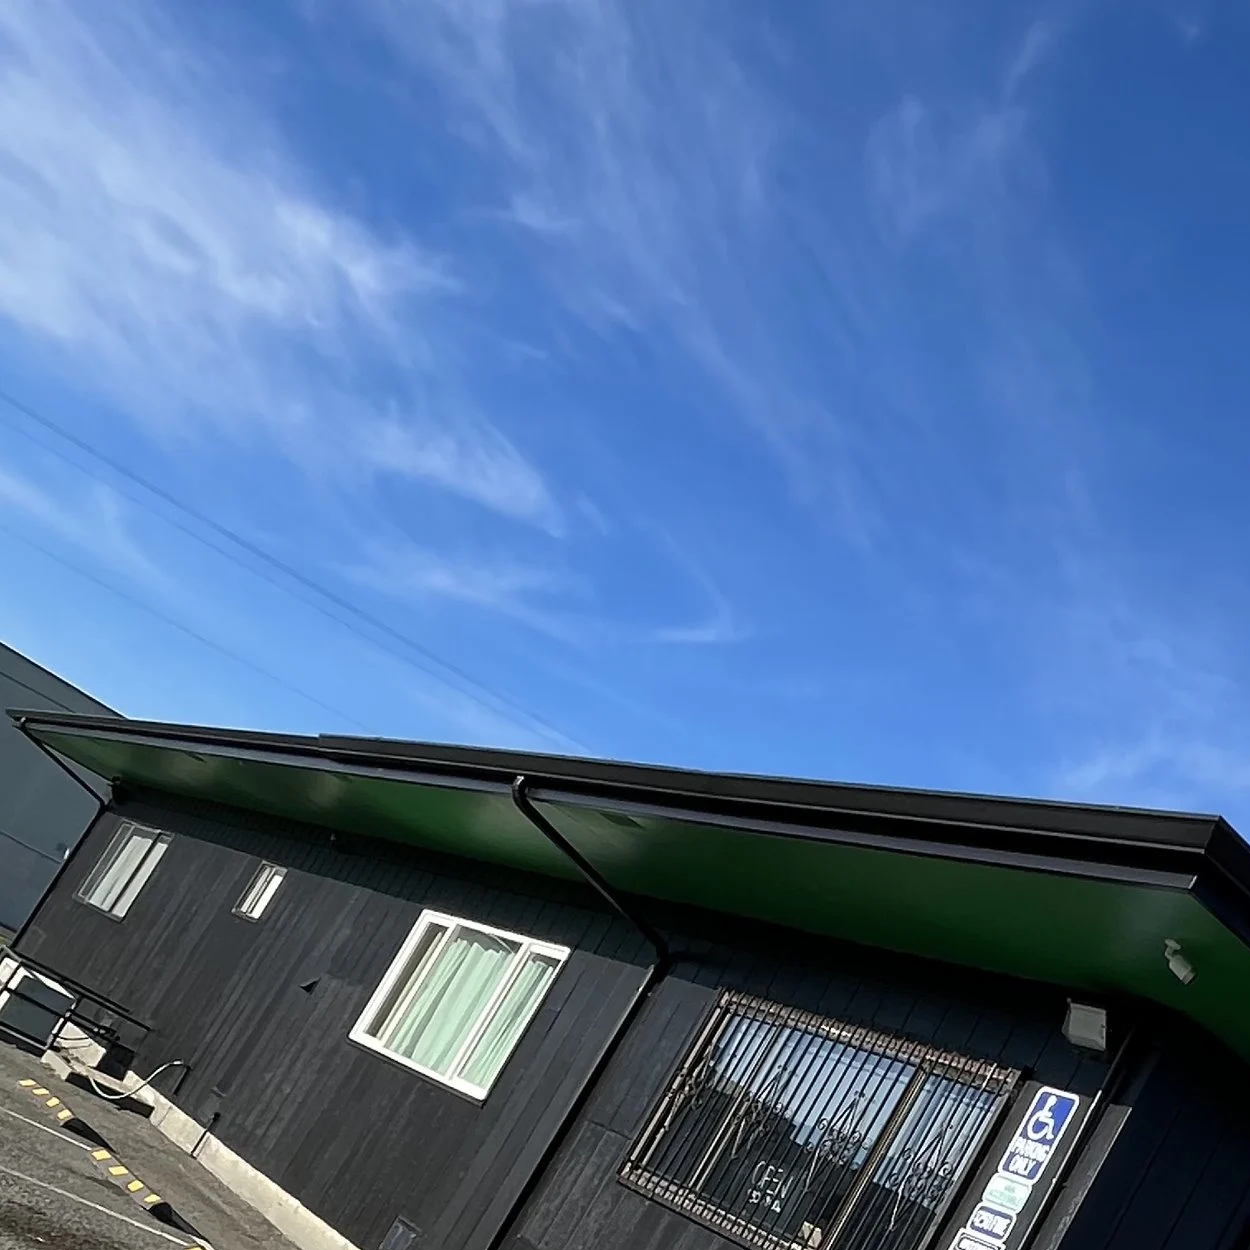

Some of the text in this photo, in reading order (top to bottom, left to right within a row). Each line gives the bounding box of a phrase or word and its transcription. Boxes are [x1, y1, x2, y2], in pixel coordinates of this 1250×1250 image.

[1010, 1136, 1051, 1162] PARKING
[1008, 1154, 1037, 1176] ONLY
[752, 1161, 793, 1198] OPEN
